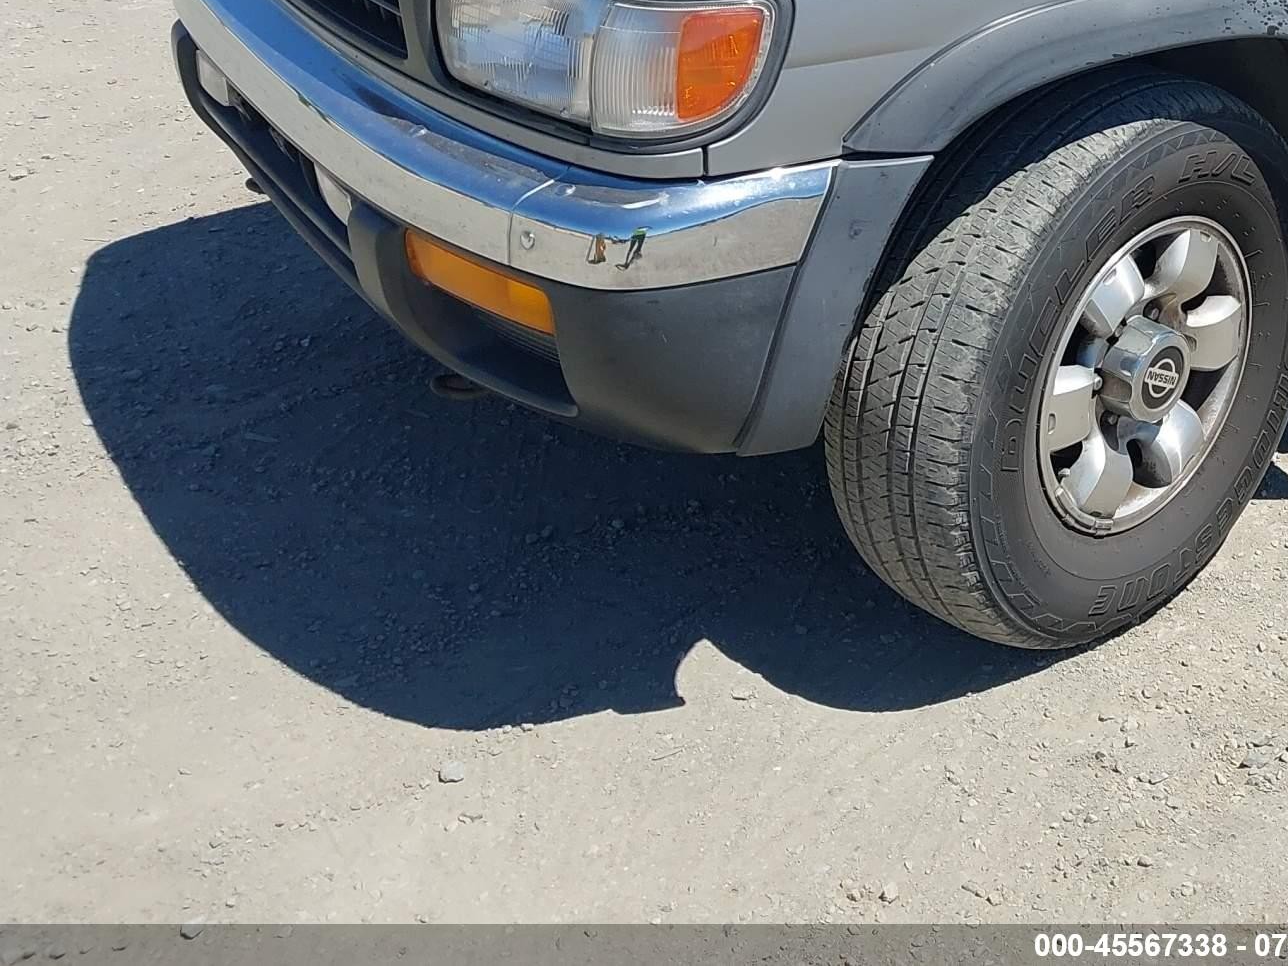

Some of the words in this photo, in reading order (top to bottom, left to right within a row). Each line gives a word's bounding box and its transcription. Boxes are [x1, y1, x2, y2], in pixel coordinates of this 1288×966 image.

[1001, 175, 1156, 474] DUELER
[1178, 150, 1257, 185] H/L
[1146, 370, 1178, 386] NISSAN
